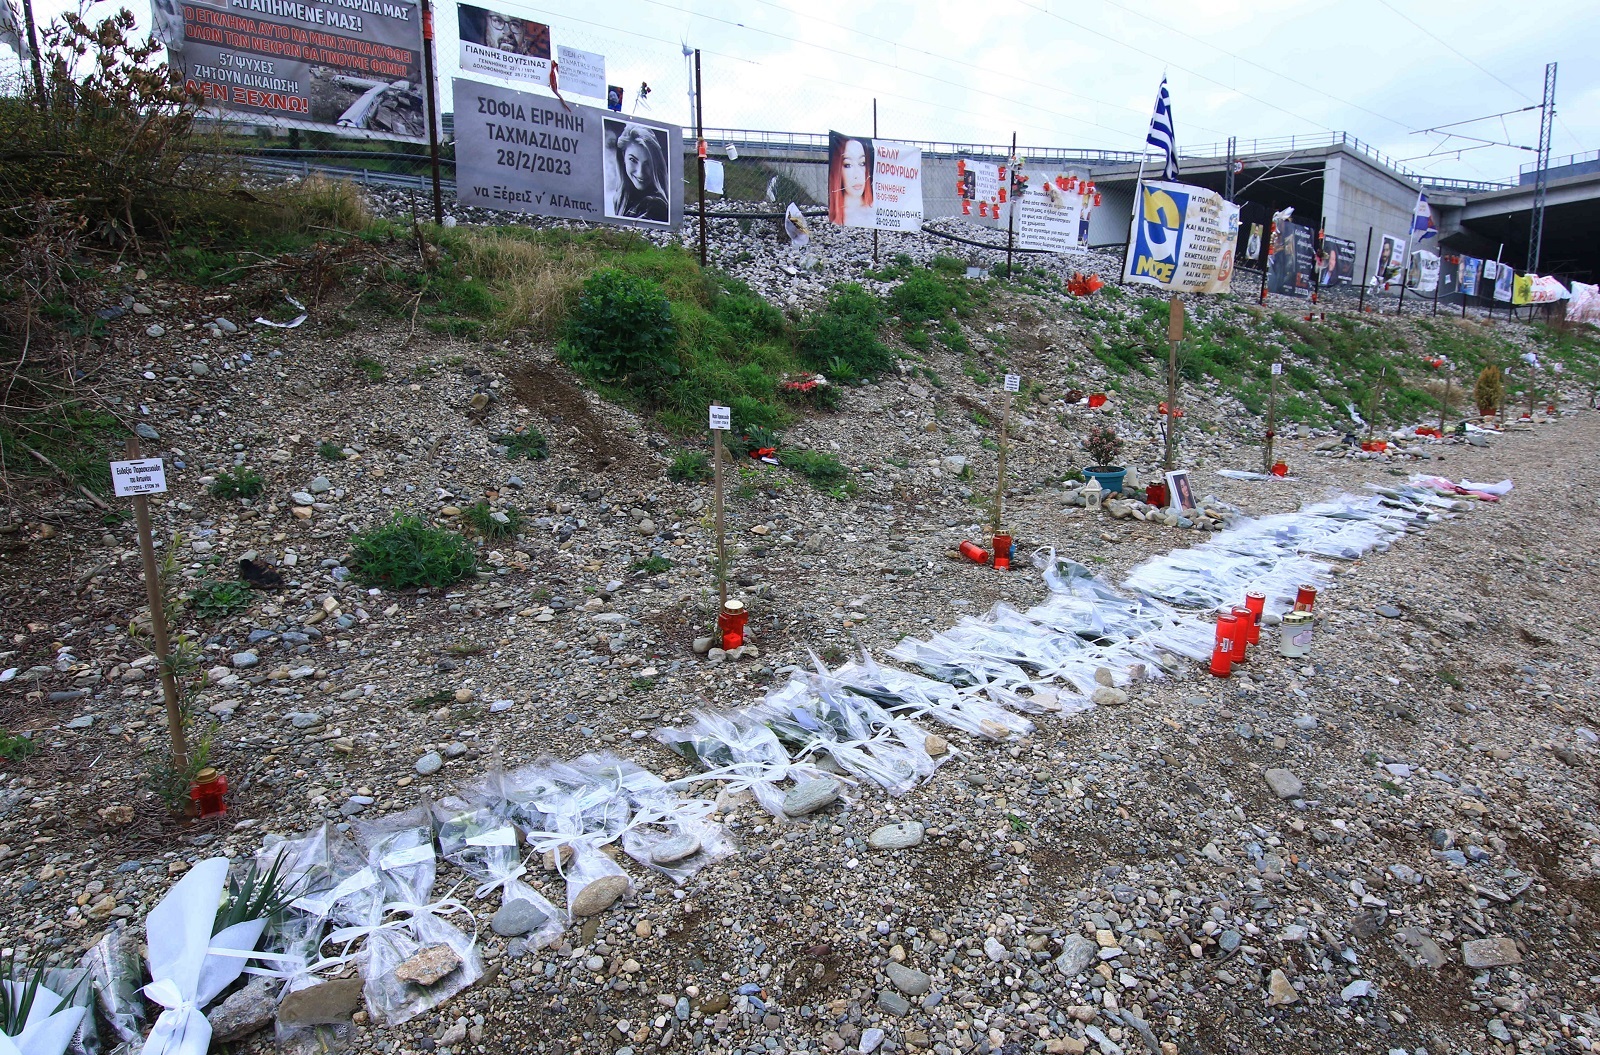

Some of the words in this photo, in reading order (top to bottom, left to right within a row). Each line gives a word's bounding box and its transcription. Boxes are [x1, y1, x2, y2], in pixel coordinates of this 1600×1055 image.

[326, 11, 362, 31] ΜΑΣ!
[384, 4, 408, 20] ΜΑΣ
[196, 9, 256, 34] ΕΓΚΛΗΜΑ
[259, 22, 289, 39] ΑΥΤΟ
[292, 28, 308, 43] ΝΑ
[310, 31, 336, 49] ΜΗΝ
[338, 37, 412, 63] ΣΥΓΚΑΛΥΦΘΕΙ
[186, 24, 222, 43] ΟΛΩΝ
[225, 31, 249, 48] ΤΩΝ
[252, 36, 300, 57] ΝΕΚΡΩΝ
[303, 46, 319, 61] ΘΑ
[320, 49, 369, 70] ΓΙΝΟΥΜΕ
[371, 59, 407, 77] ΦΩΝΗ!
[466, 45, 500, 60] ΓΙΑΝΝΗΣ
[503, 55, 546, 68] ΒΟΥΤΣΙΝΑΣ
[220, 53, 233, 66] 57
[235, 57, 274, 74] ΨΥΧΕΣ
[473, 63, 512, 76] ΔΟΛΟΦΟΝΗΘΗΚΕ
[479, 58, 507, 69] ΓΕΝΝΗΘΗΚΕ
[194, 65, 241, 83] ΖΗΤΟΥΝ
[244, 74, 298, 93] ΔΙΚΑΙΩΣΗ!
[232, 86, 308, 113] ΞΕΧΝΩ!
[478, 97, 526, 121] ΣΟΦΙΑ
[531, 108, 584, 132] ΕΙΡΗΝΗ
[486, 123, 579, 154] ΤΑΧΜΑΖΙΔΟΥ
[497, 149, 571, 175] 28/2/2023
[877, 146, 899, 160] ΚΕΛΛΥ
[876, 162, 918, 180] ΠΟΡΦΥΡΙΔΟΥ
[474, 186, 489, 197] να
[493, 186, 532, 203] ΞέρειΣ
[876, 182, 906, 194] ΓΕΝΝΗΘΗΚΕ
[876, 208, 921, 219] ΔΟΛΟΦΟΝΗΘΗΚΕ
